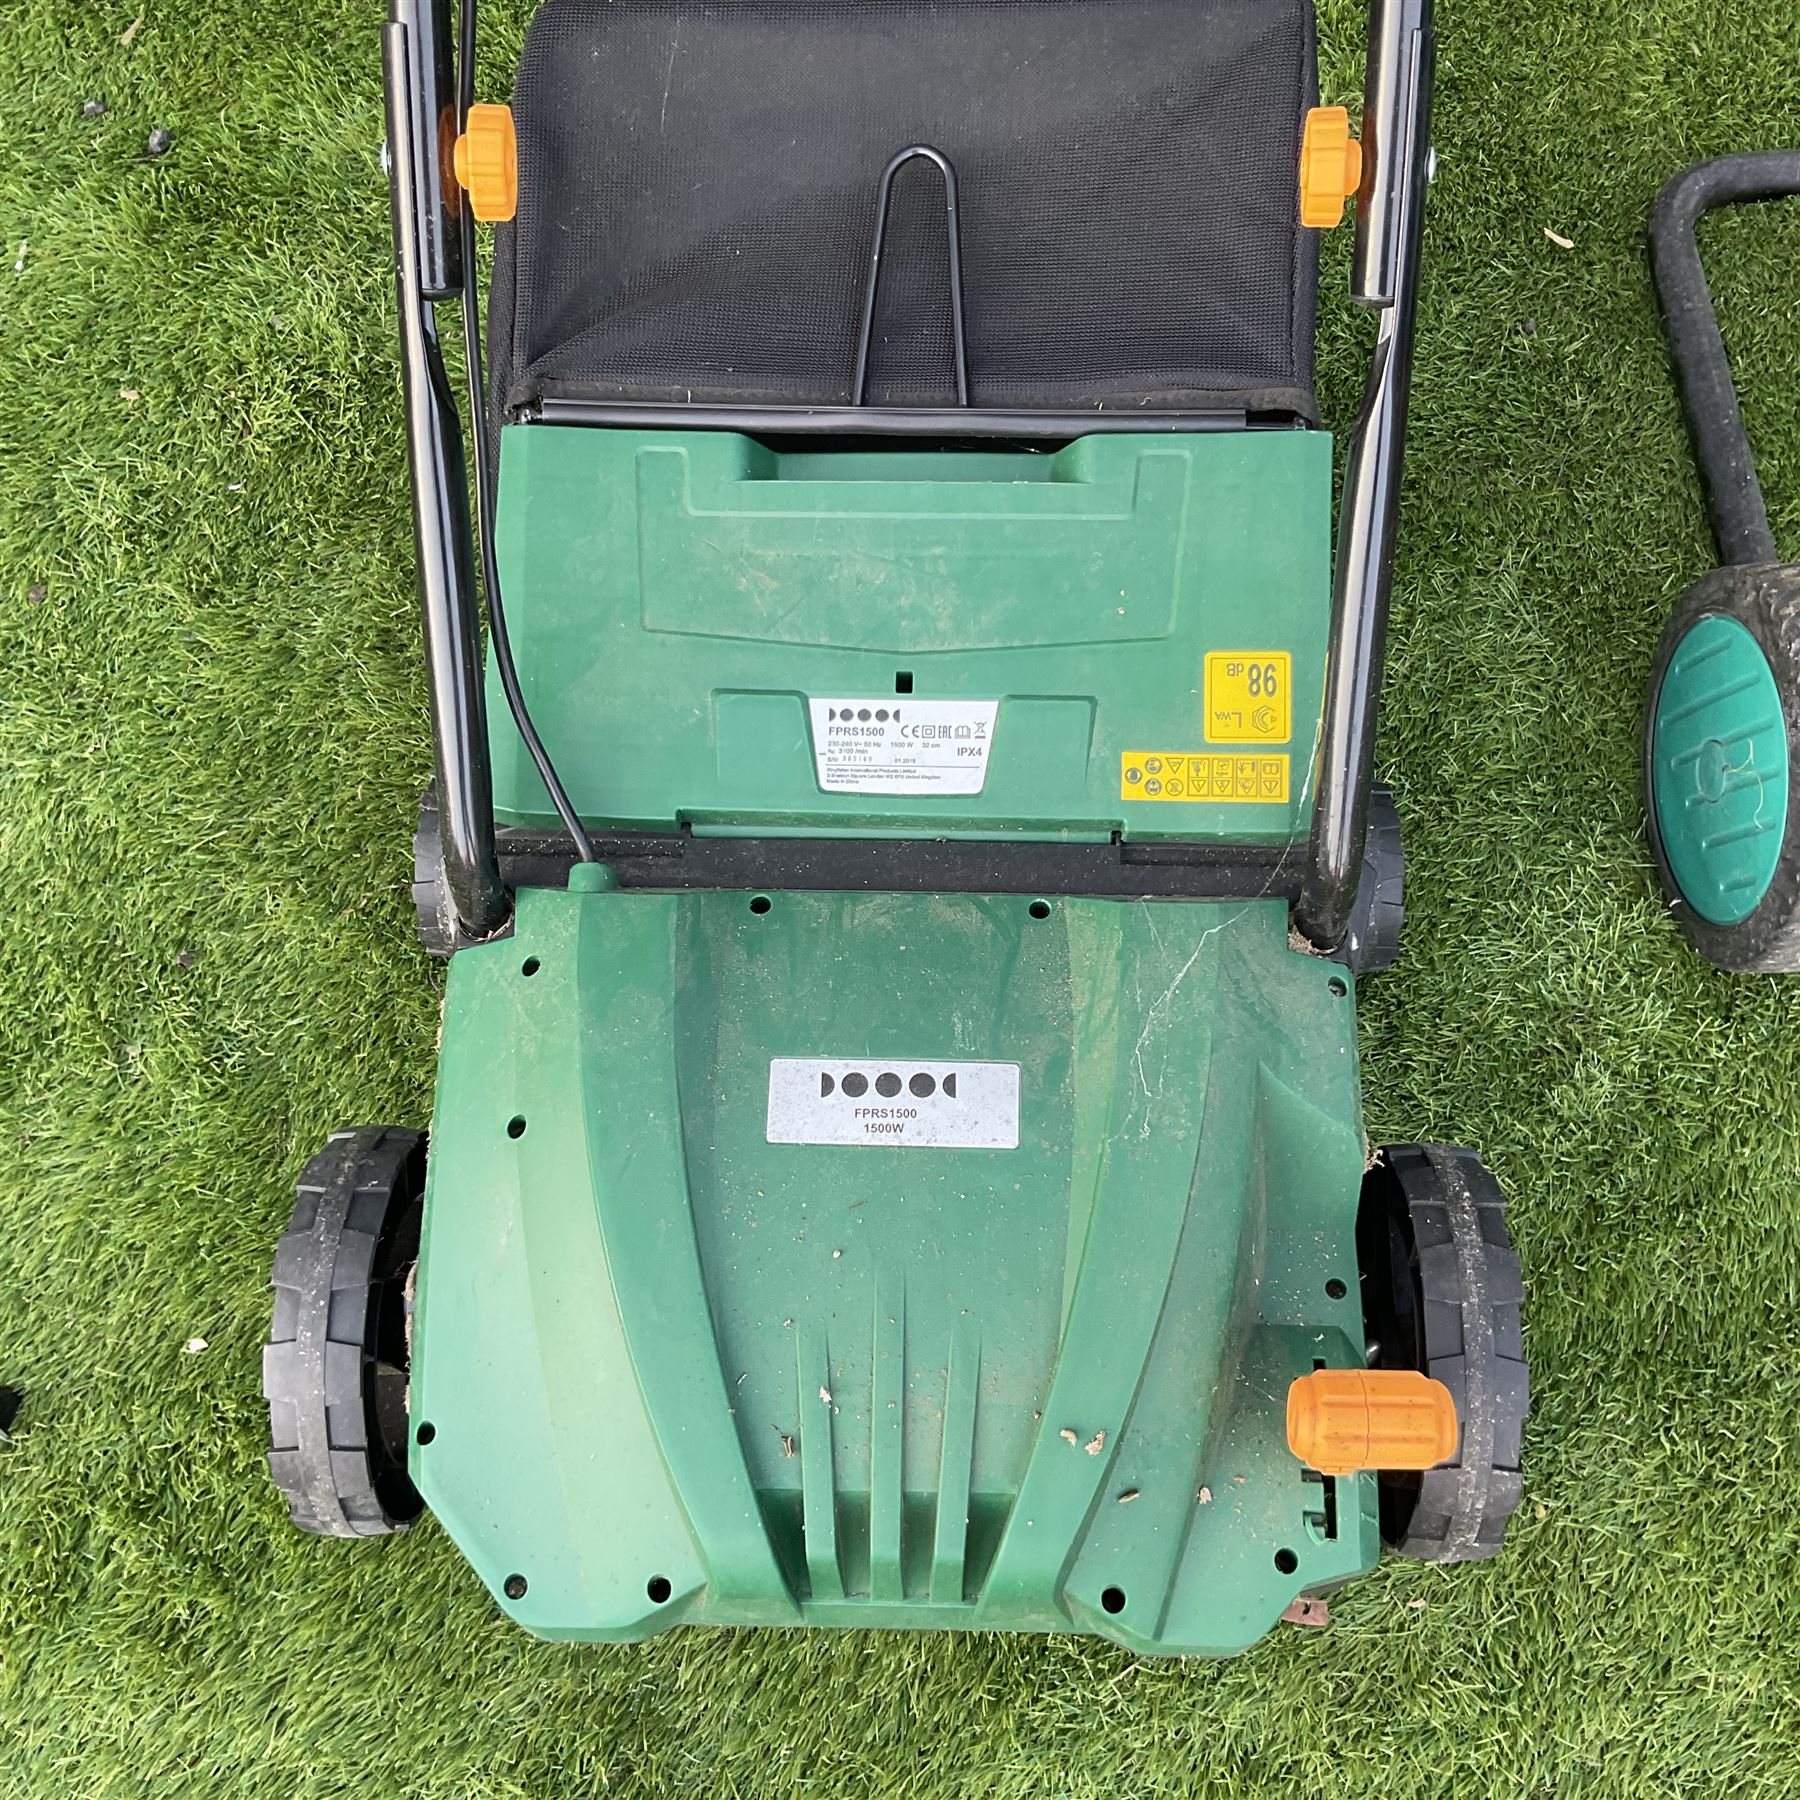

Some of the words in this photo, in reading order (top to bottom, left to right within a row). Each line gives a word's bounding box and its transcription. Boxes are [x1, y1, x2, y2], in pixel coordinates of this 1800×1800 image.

[1226, 663, 1244, 677] dB
[1248, 663, 1277, 698] 98
[828, 727, 885, 737] FPRS1500
[957, 747, 983, 757] IPX4
[854, 1108, 917, 1119] FPRS1500
[864, 1123, 905, 1134] 1500W
